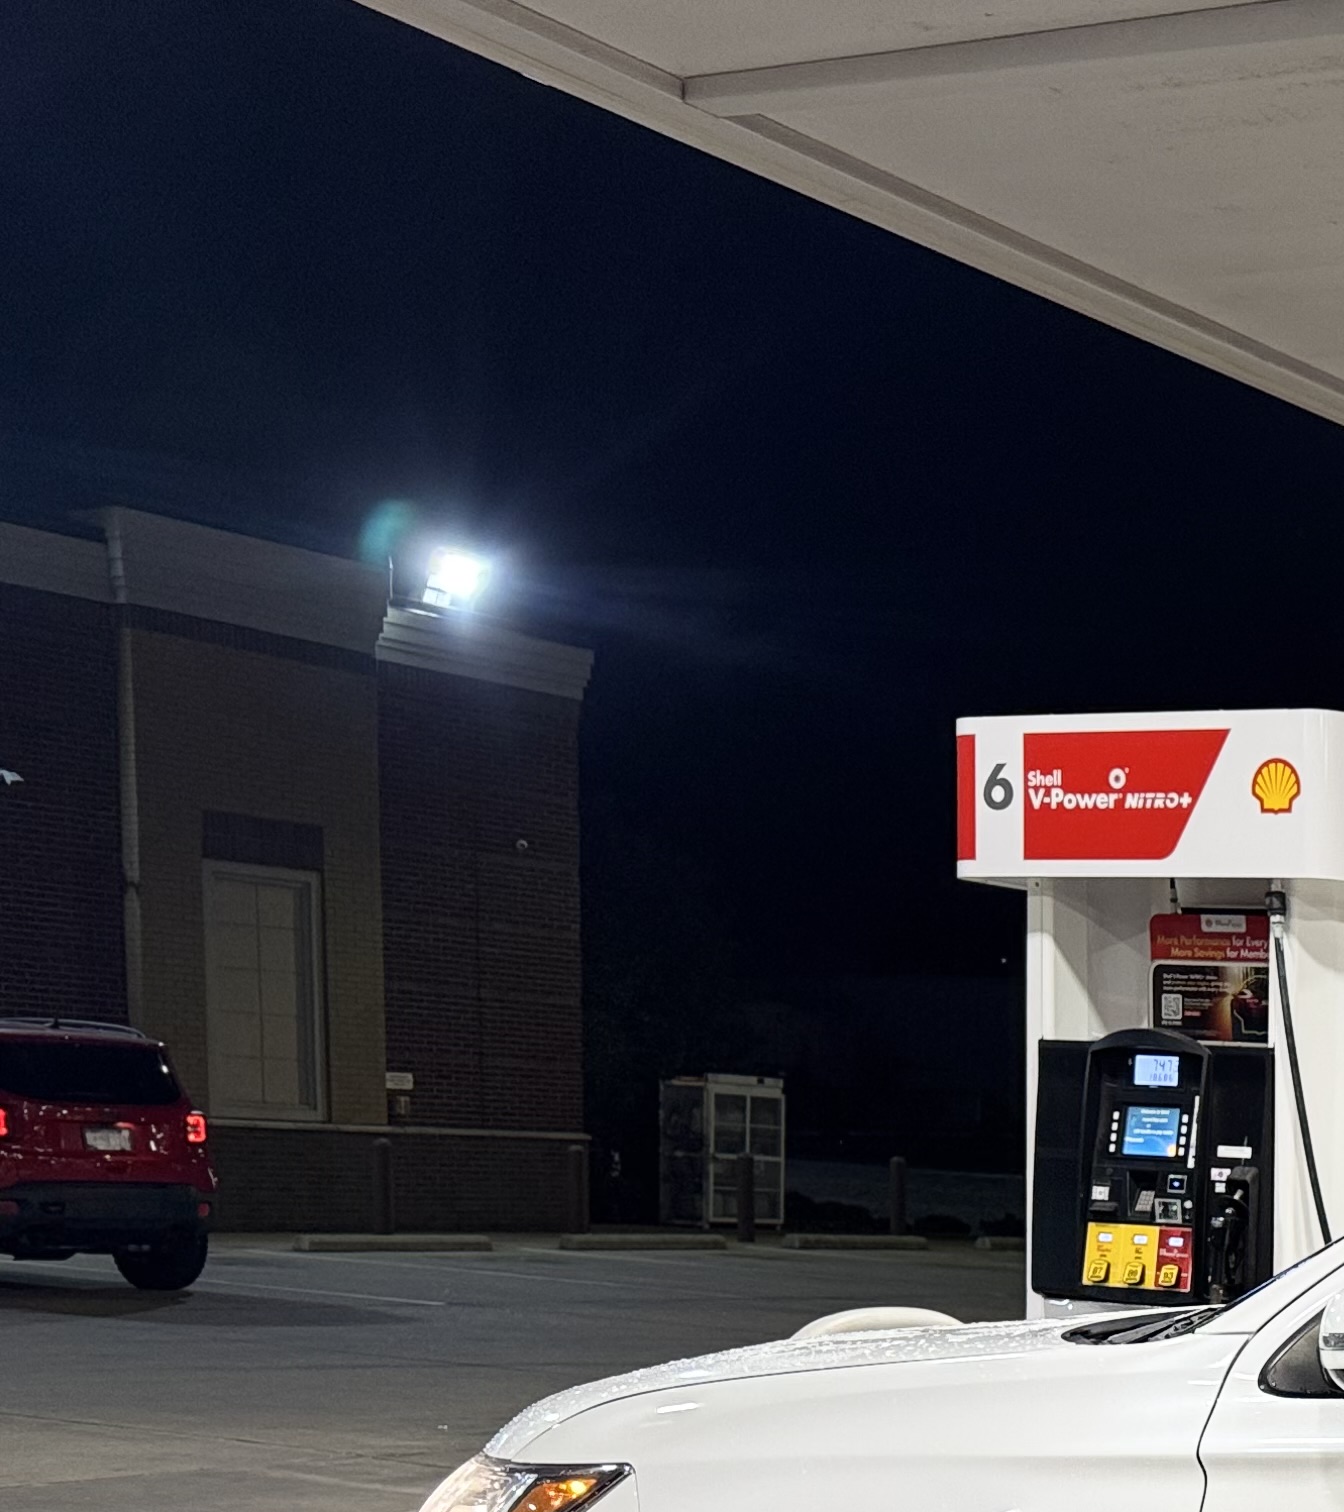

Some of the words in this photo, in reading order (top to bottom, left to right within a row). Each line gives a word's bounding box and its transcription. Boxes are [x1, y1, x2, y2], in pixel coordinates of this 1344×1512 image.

[983, 762, 1014, 810] 6
[1027, 768, 1062, 787] Shell
[1028, 788, 1118, 810] V-Power
